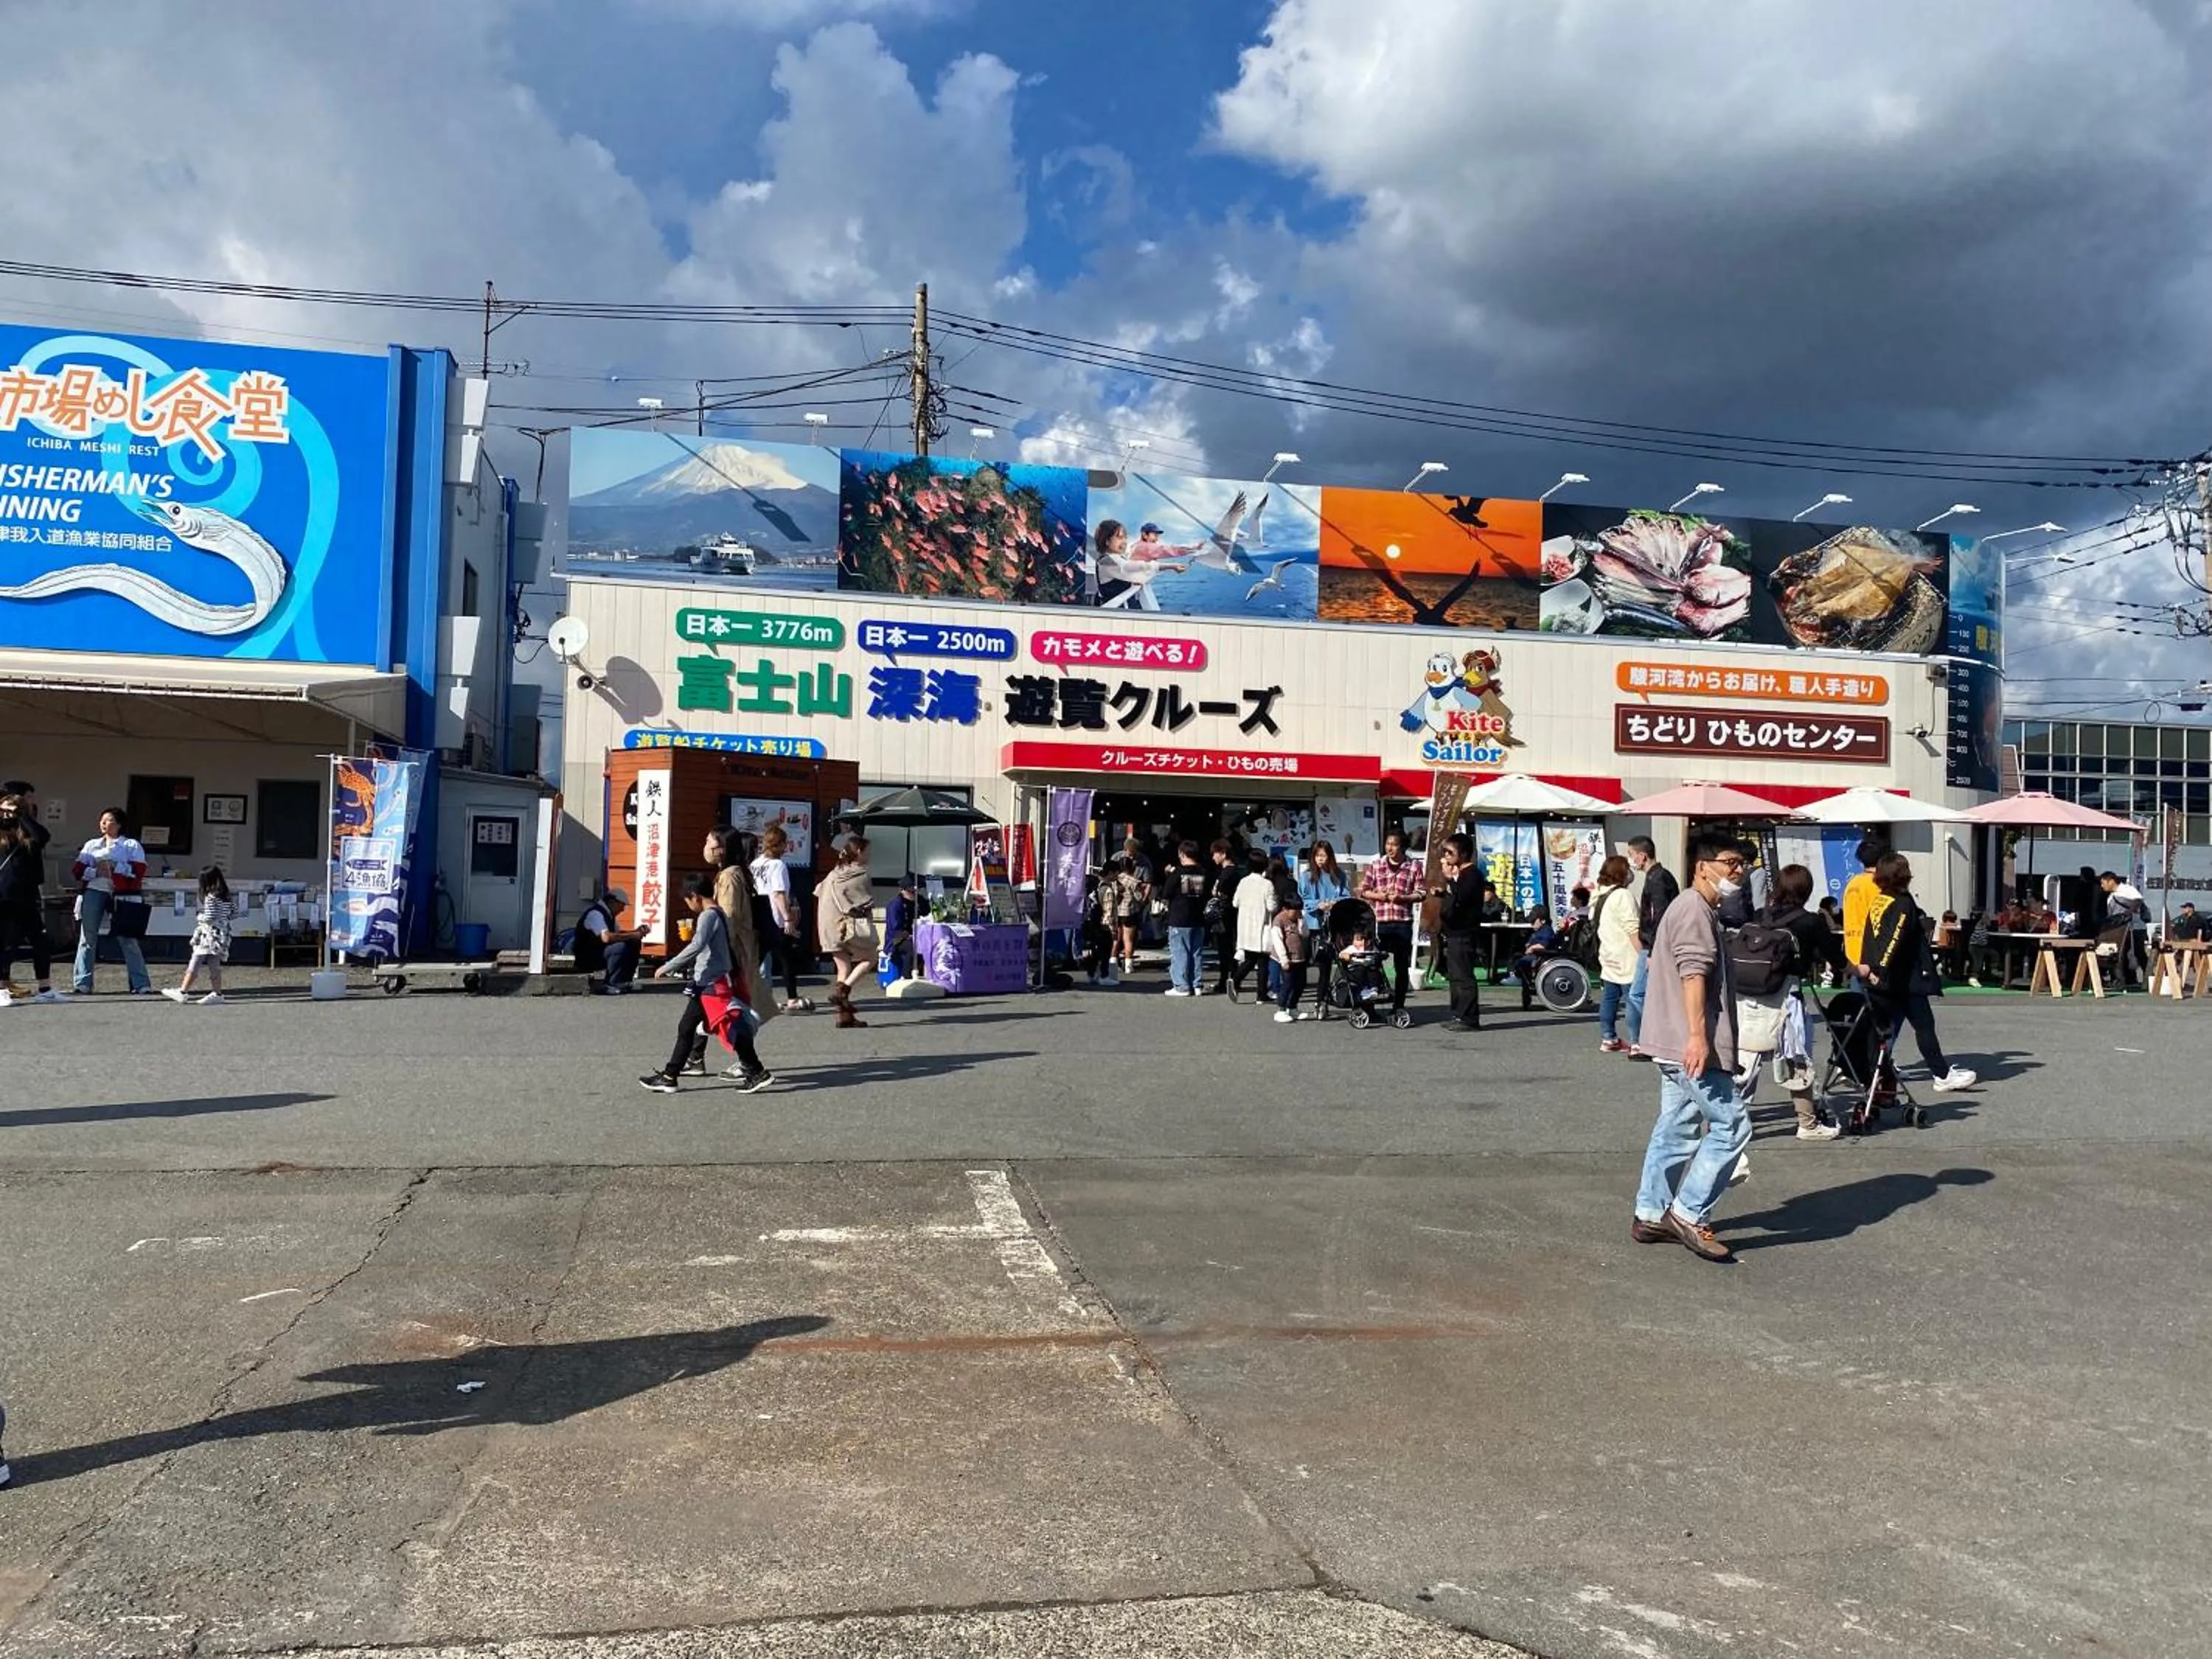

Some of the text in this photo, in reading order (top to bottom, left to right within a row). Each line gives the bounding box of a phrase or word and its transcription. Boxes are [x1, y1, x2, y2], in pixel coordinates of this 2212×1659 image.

[0, 366, 287, 460] 市場めし食堂
[27, 437, 160, 457] ICHIBA MESHI REST
[0, 464, 175, 498] ISHERMAN'S
[0, 495, 83, 523] INING
[686, 613, 833, 643] 日本一 3776m
[866, 625, 1006, 653] 日本一 2500m
[1042, 636, 1199, 664] カモメと遊べる！
[677, 654, 852, 718] 富士山
[866, 664, 981, 724] 深海
[1004, 674, 1283, 736] 遊覧クルーズ
[1447, 711, 1504, 732] Kite
[1627, 714, 1877, 752] ちどり ひものセンター
[1100, 750, 1299, 774] クルーズチケット・ひもの売場
[1422, 740, 1503, 762] Sailor
